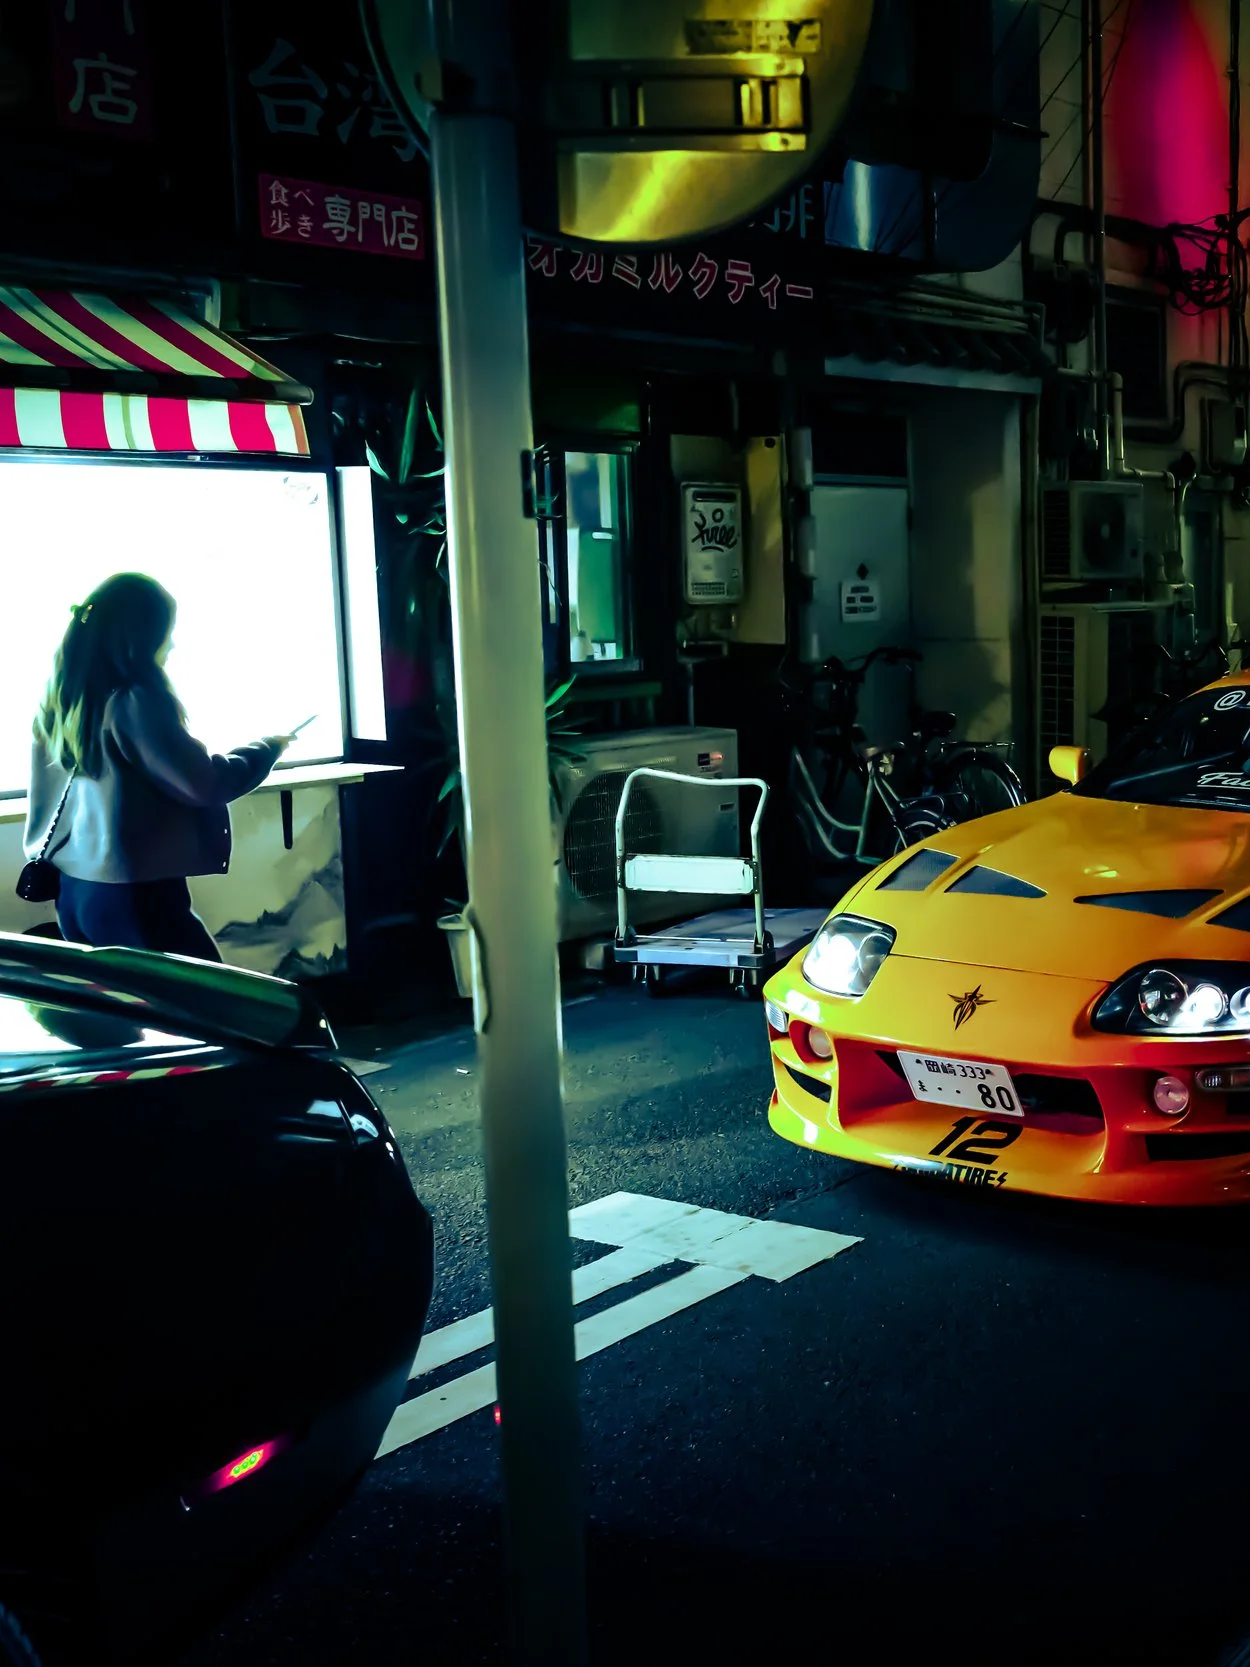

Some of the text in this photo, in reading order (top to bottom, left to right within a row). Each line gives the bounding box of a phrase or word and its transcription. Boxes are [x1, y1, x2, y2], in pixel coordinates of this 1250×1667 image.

[268, 179, 316, 208] 食べ
[269, 210, 316, 239] 歩き
[322, 193, 420, 253] 専門店
[956, 1064, 987, 1080] 333
[977, 1083, 1016, 1112] 80
[928, 1116, 1024, 1166] 12
